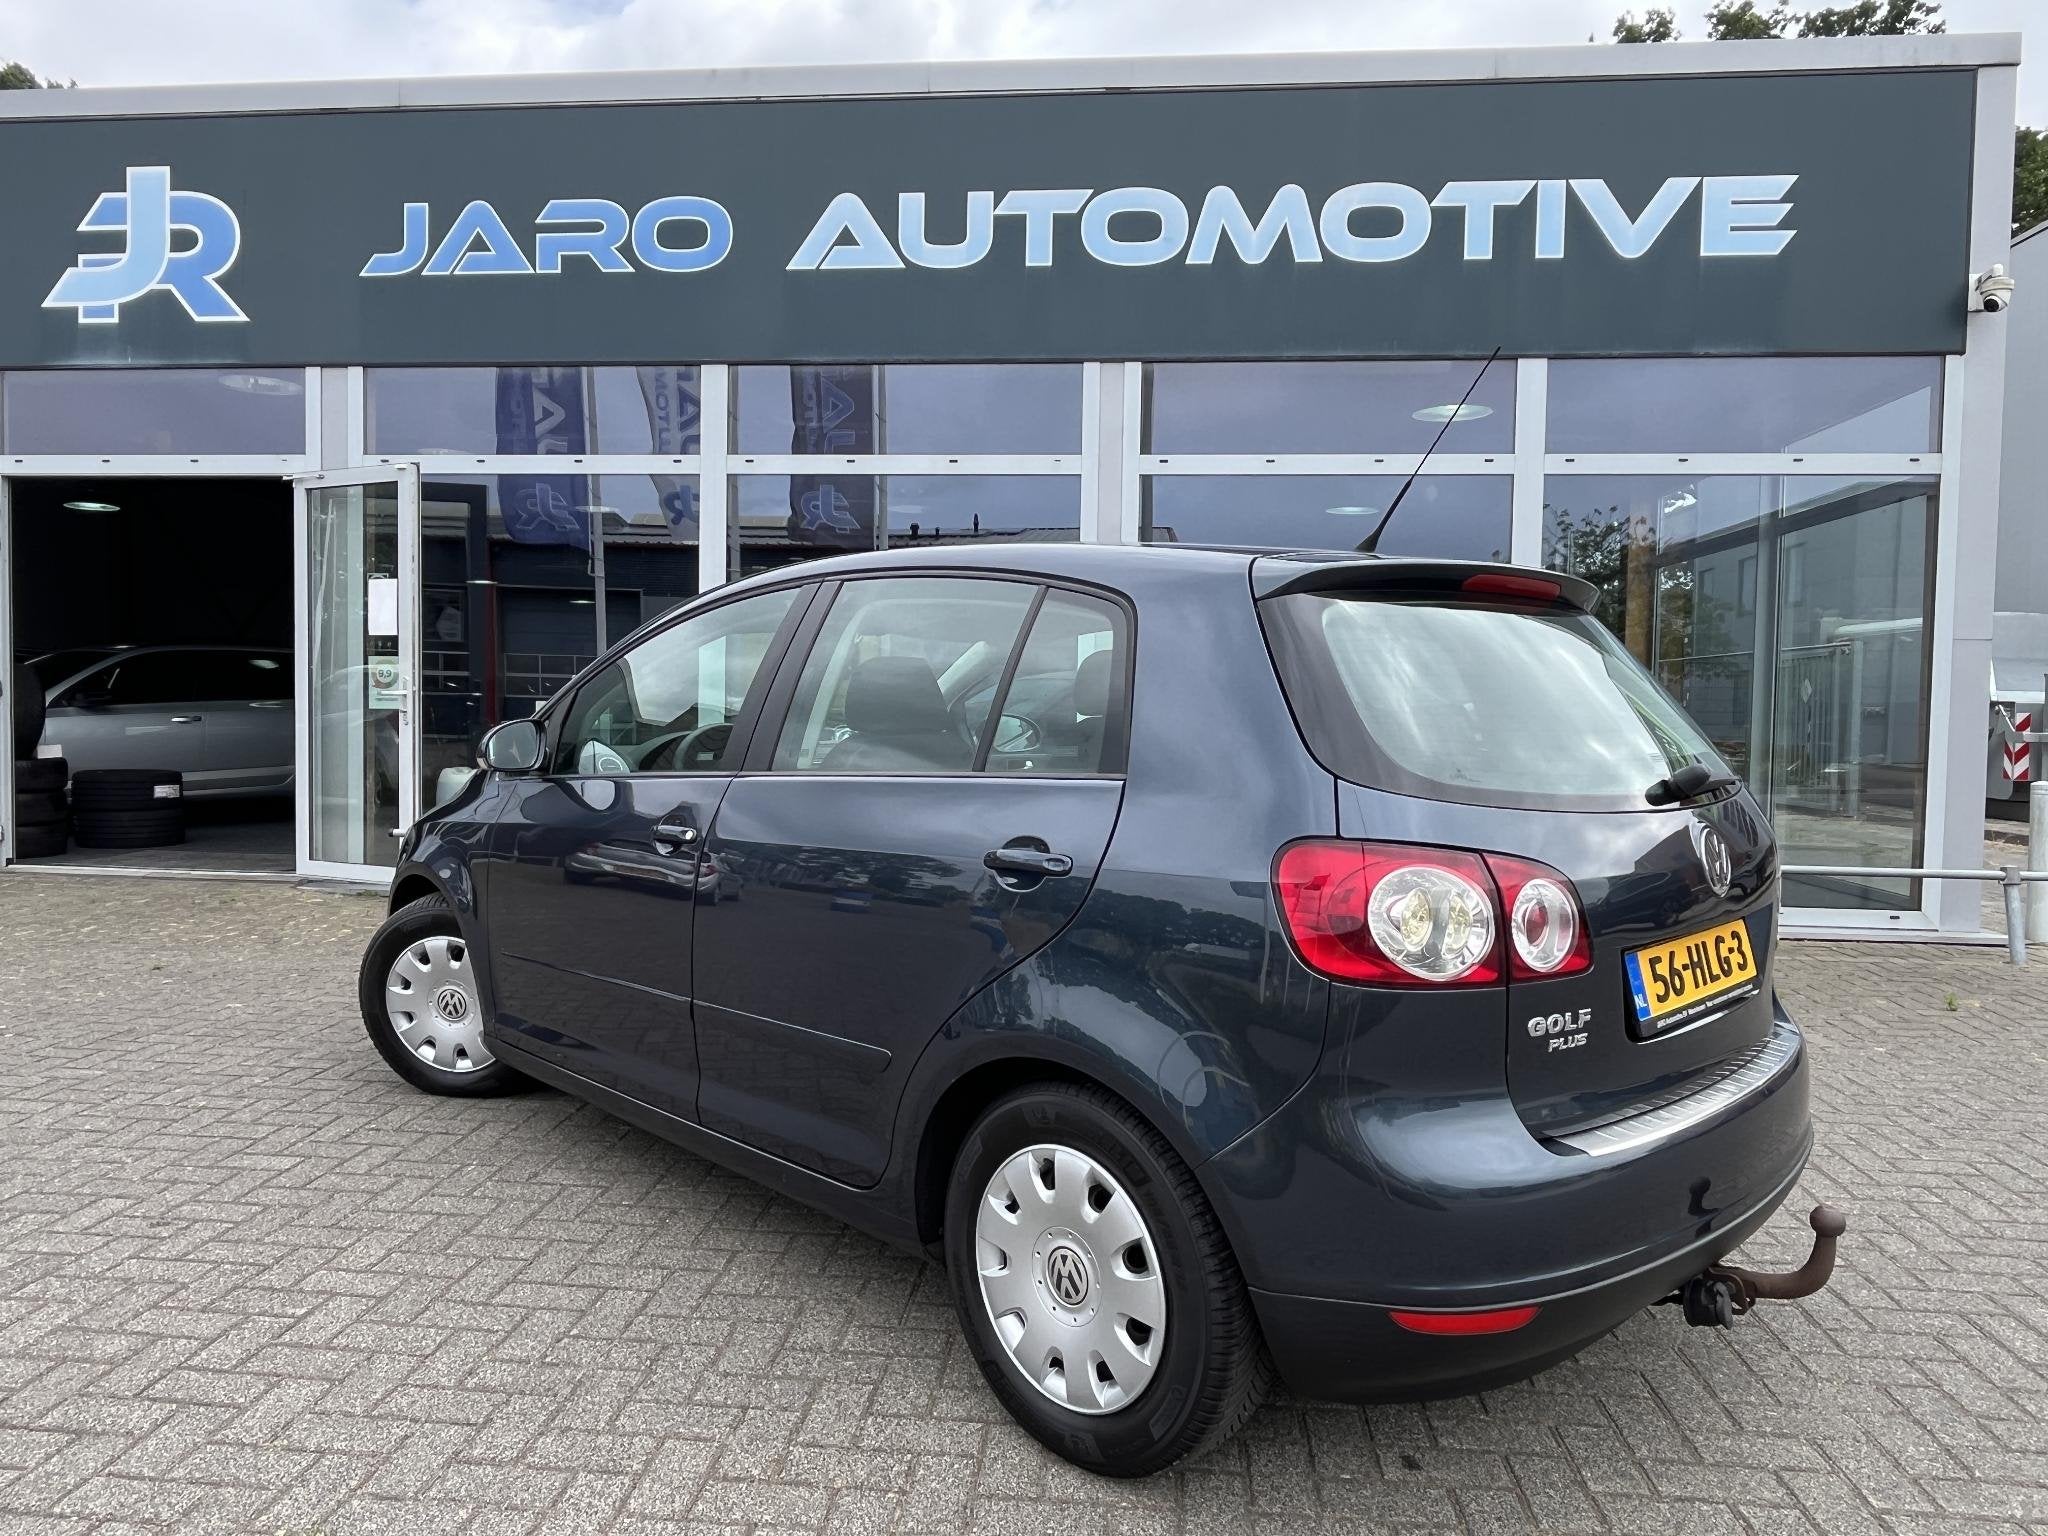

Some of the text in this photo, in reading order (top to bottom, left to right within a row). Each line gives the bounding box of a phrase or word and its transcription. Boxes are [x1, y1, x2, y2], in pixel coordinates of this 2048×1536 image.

[359, 173, 1800, 278] JARO AUTOMOTIVE
[1649, 930, 1748, 1004] 56-HLG-3
[1634, 995, 1648, 1009] NL
[1527, 1008, 1592, 1037] GOLF
[1548, 1033, 1588, 1052] PLUS
